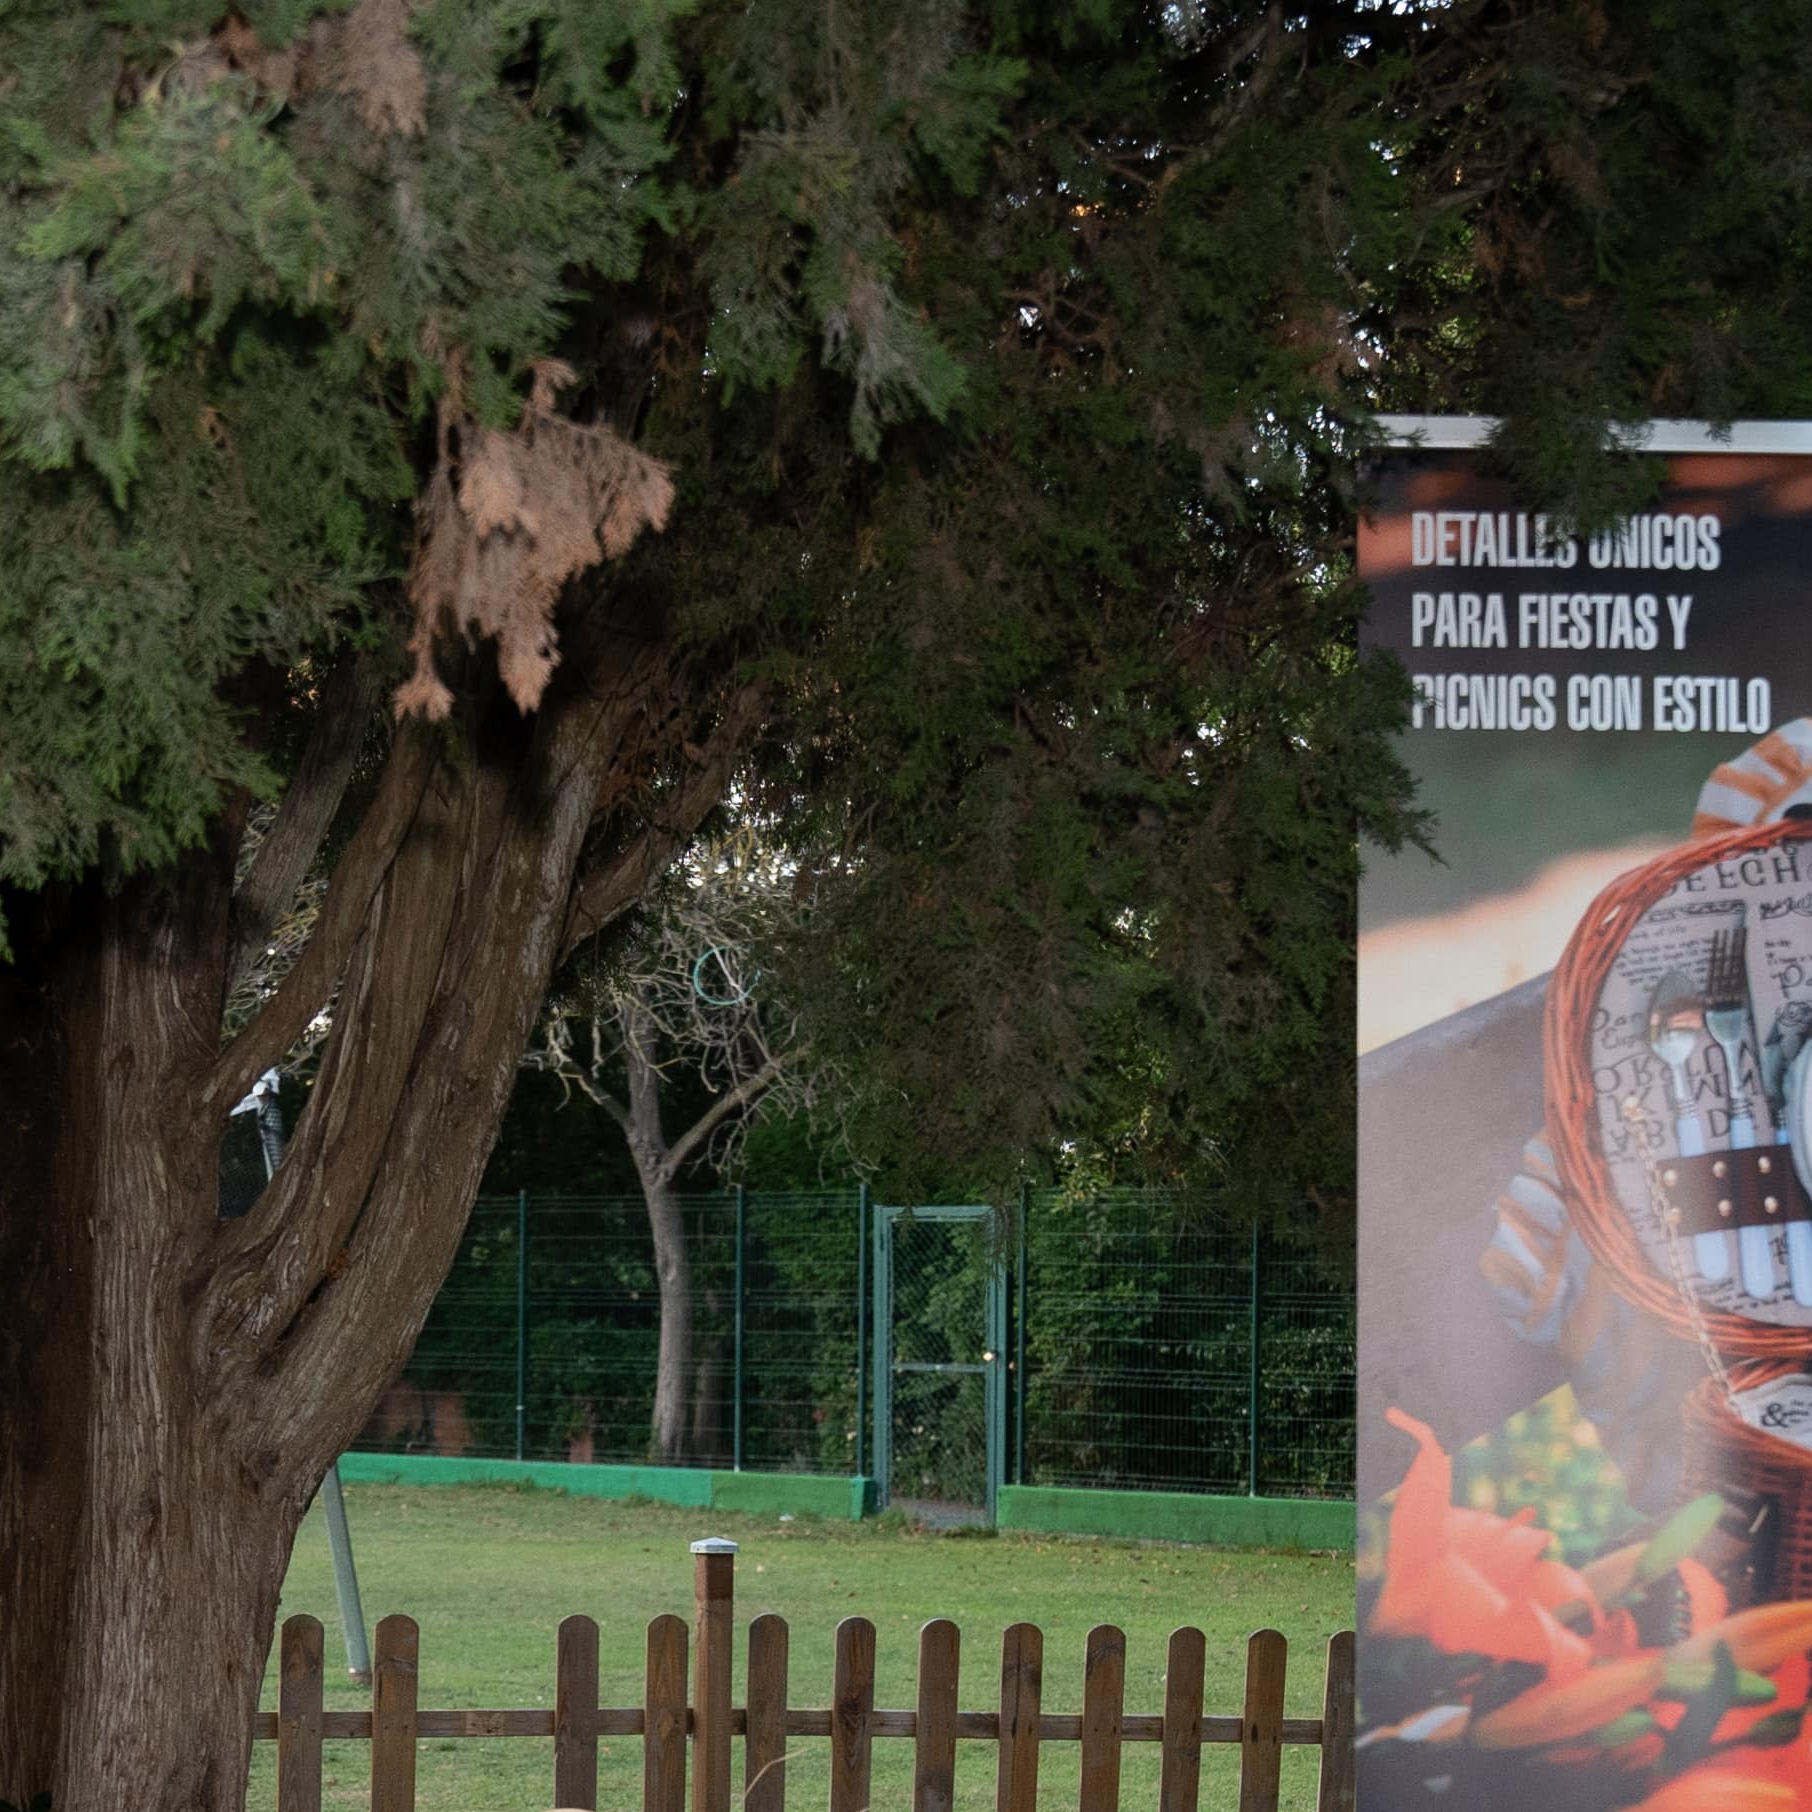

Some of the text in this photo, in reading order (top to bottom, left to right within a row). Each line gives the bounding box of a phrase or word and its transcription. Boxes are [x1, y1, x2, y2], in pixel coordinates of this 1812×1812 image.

[1411, 592, 1693, 651] PARA FIESTAS Y
[1411, 673, 1772, 735] PICNICS CON ESTILO
